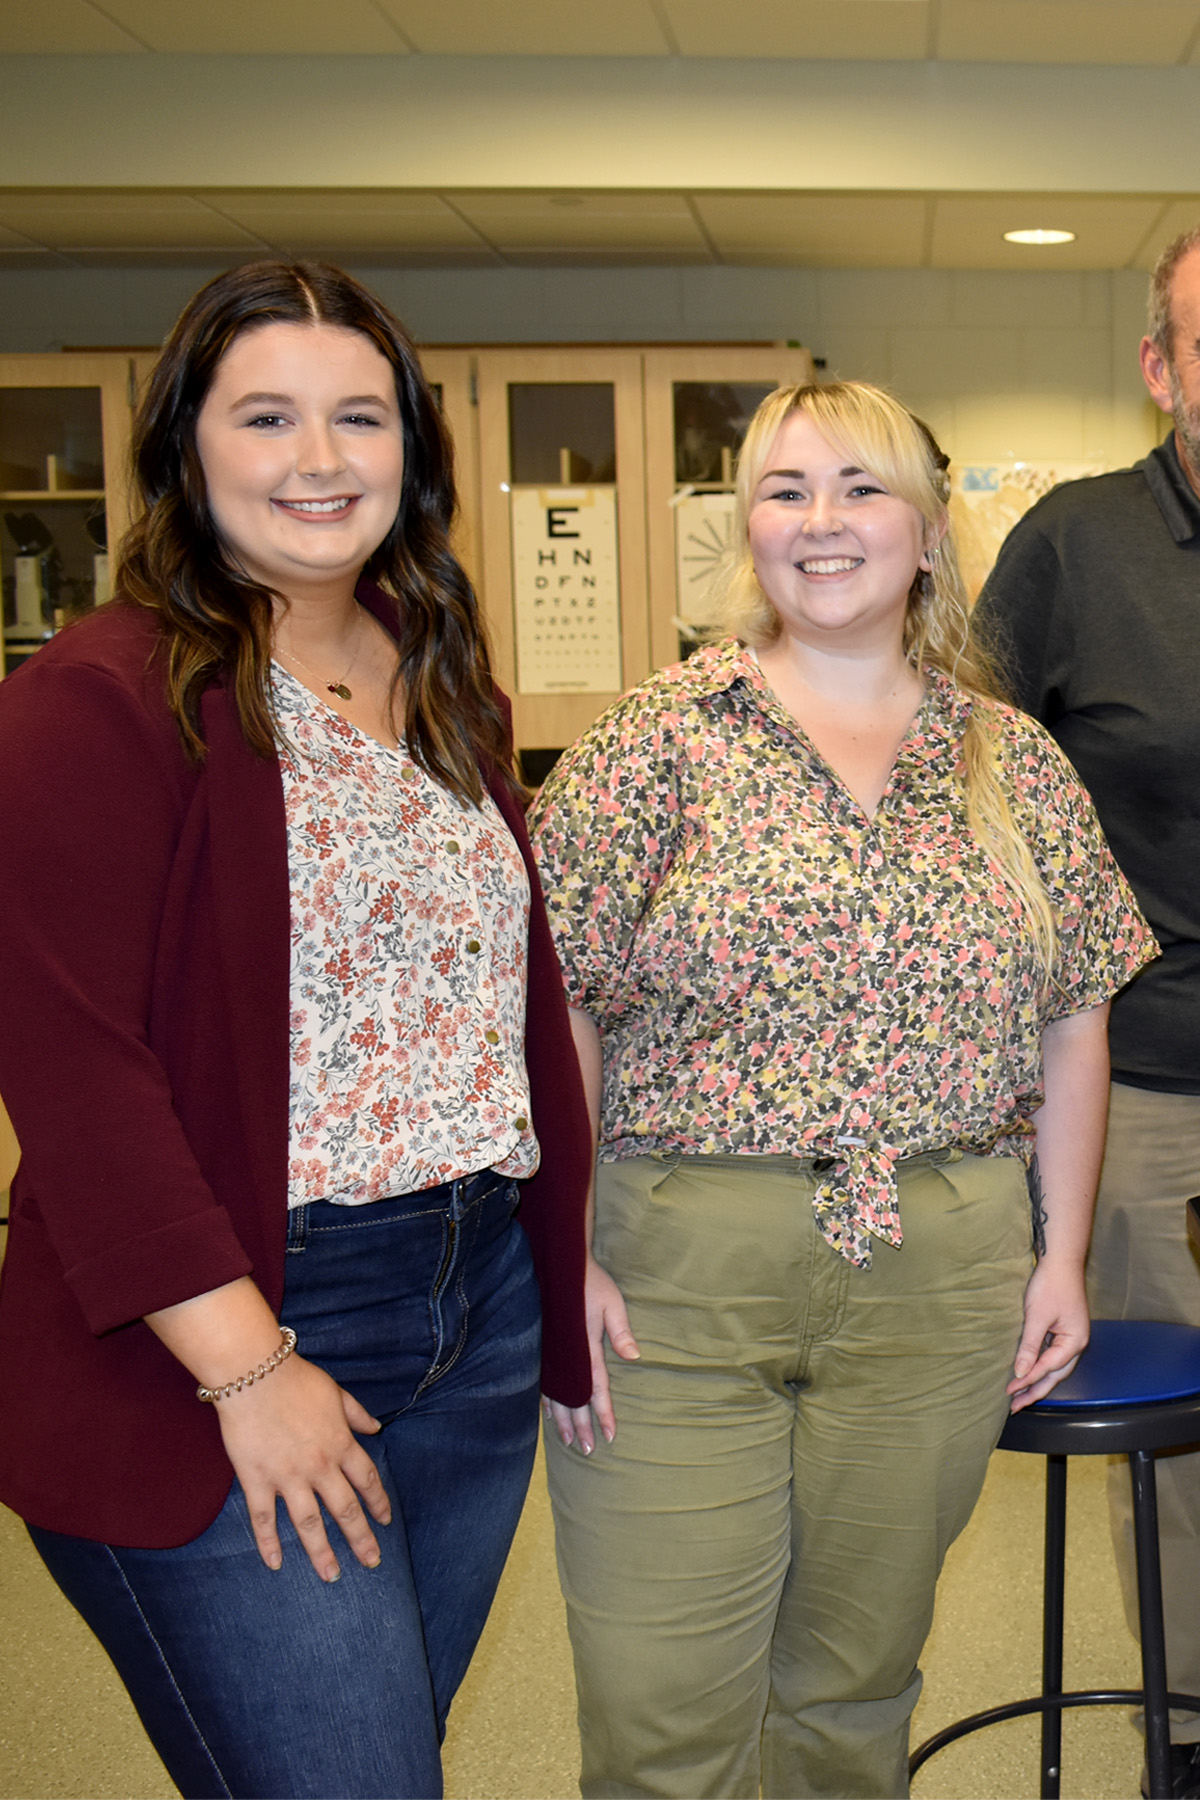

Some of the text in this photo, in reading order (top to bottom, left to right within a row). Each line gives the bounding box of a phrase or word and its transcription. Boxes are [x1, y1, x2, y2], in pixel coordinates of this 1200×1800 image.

[547, 507, 580, 538] E
[538, 549, 591, 566] H N
